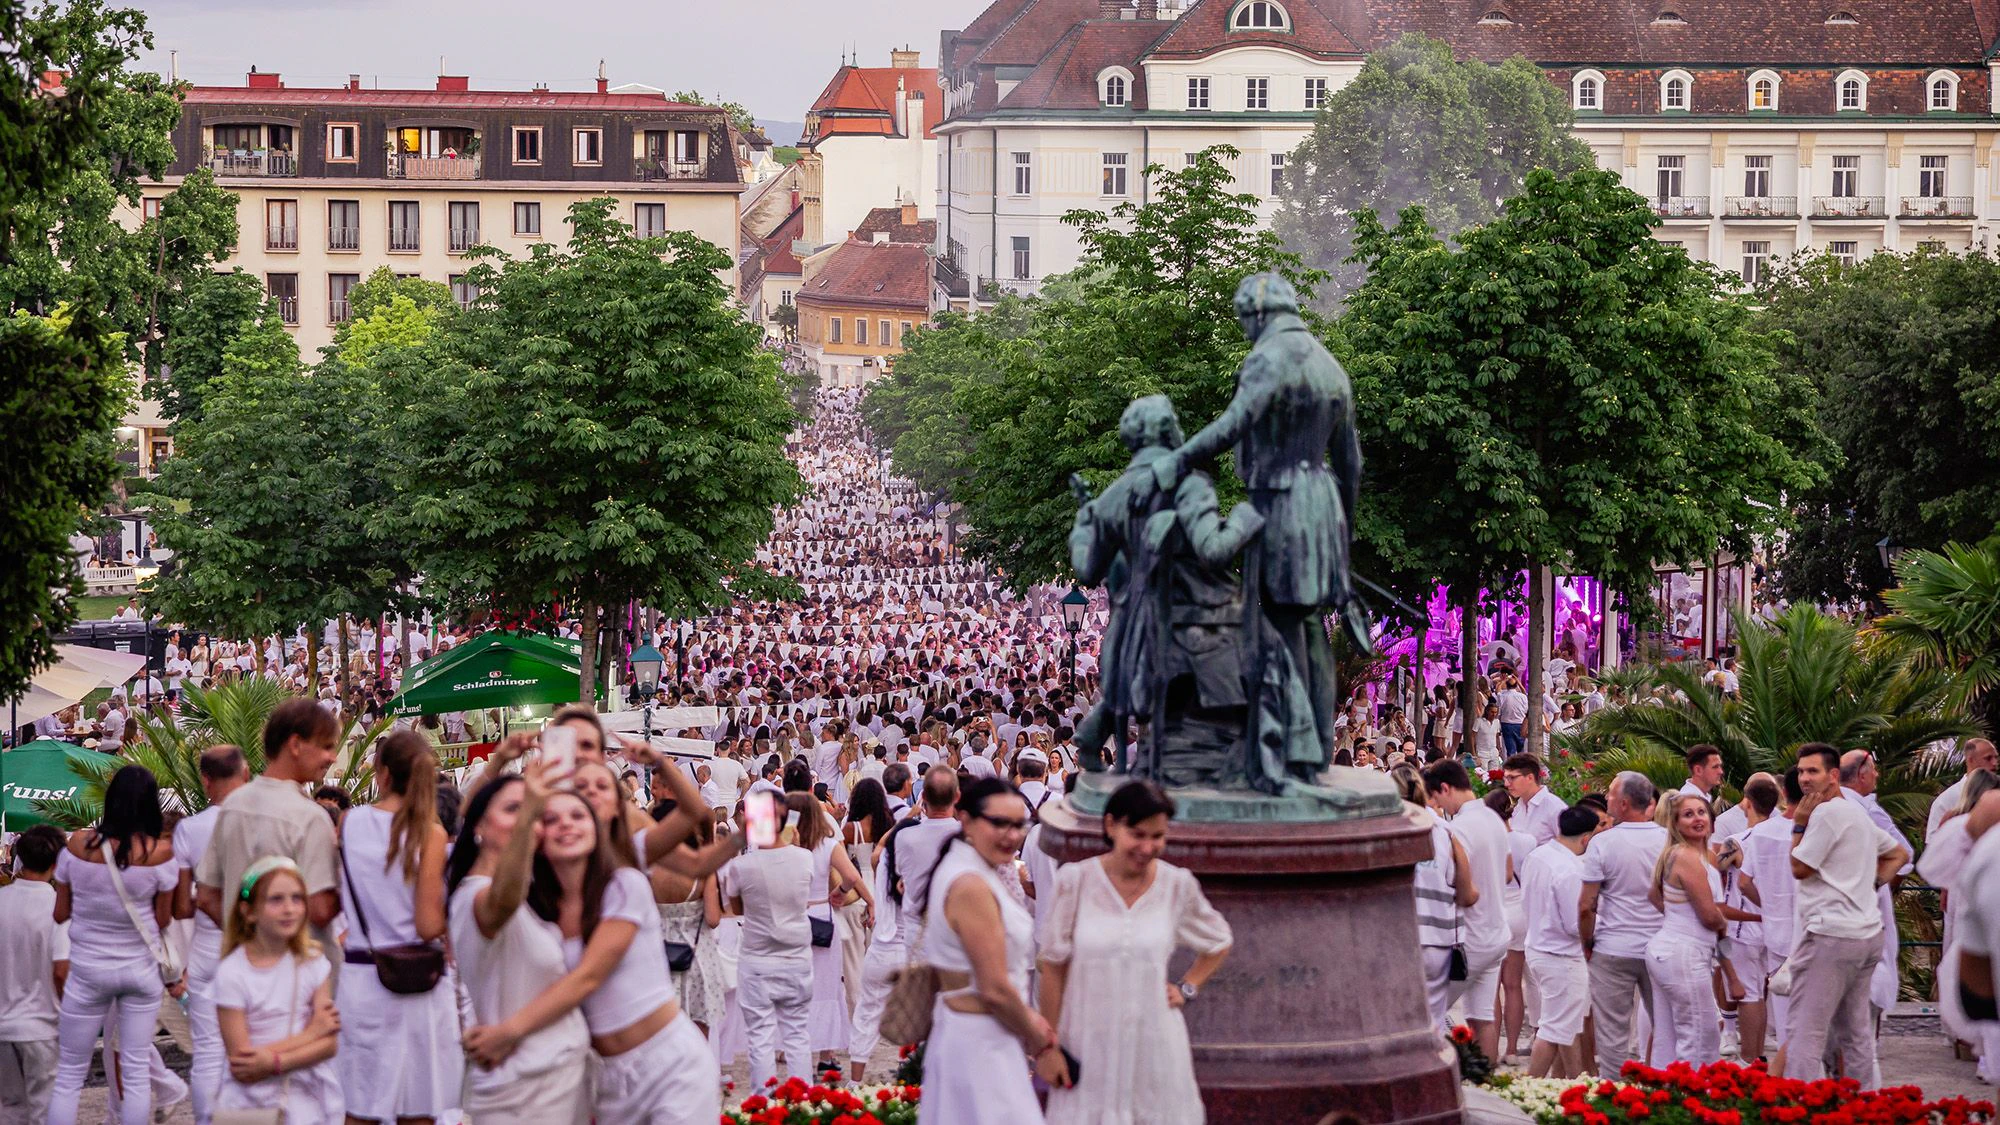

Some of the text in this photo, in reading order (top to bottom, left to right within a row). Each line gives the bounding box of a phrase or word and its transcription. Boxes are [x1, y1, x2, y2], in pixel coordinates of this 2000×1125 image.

[453, 678, 539, 691] Schladminger
[406, 703, 422, 713] uns!
[12, 786, 77, 801] uns!
